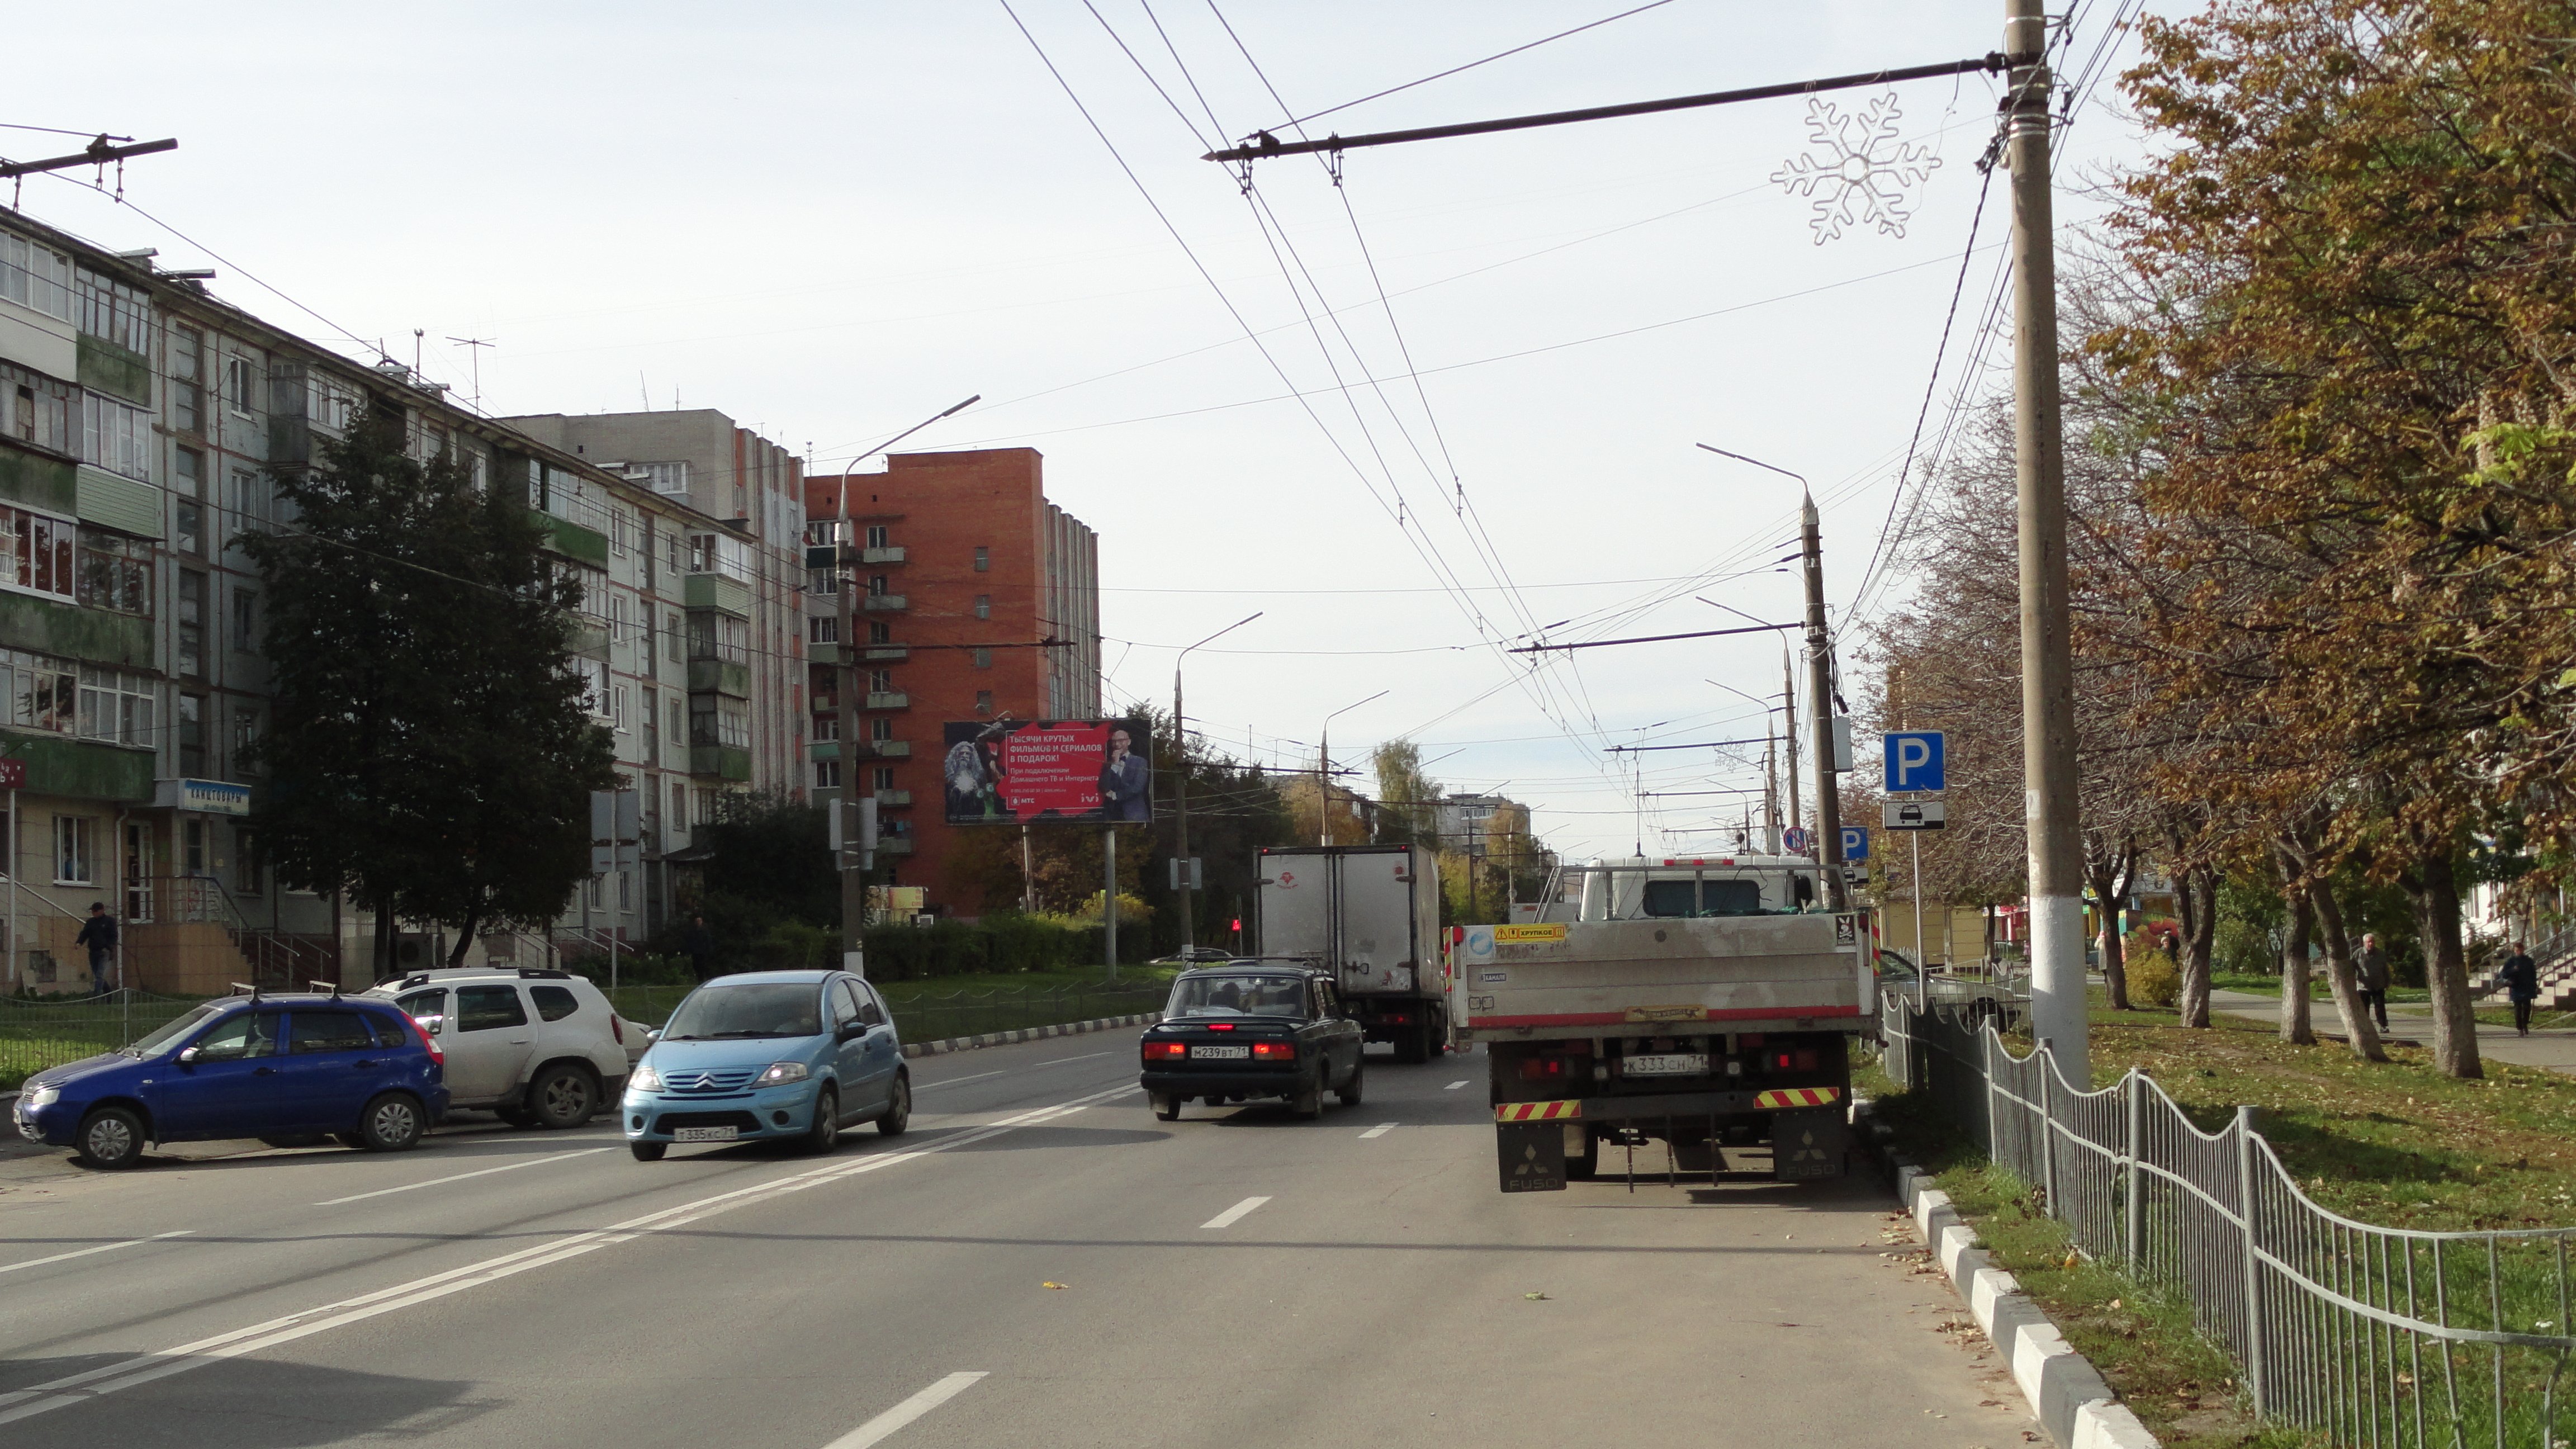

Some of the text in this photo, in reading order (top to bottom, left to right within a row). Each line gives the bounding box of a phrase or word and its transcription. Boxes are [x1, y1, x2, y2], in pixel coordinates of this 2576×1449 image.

[1017, 755, 1059, 763] ПОДАРОК!
[1898, 737, 1930, 785] P
[1842, 830, 1860, 856] P
[1787, 1164, 1836, 1176] FUSO
[1510, 1178, 1557, 1190] FUSO
